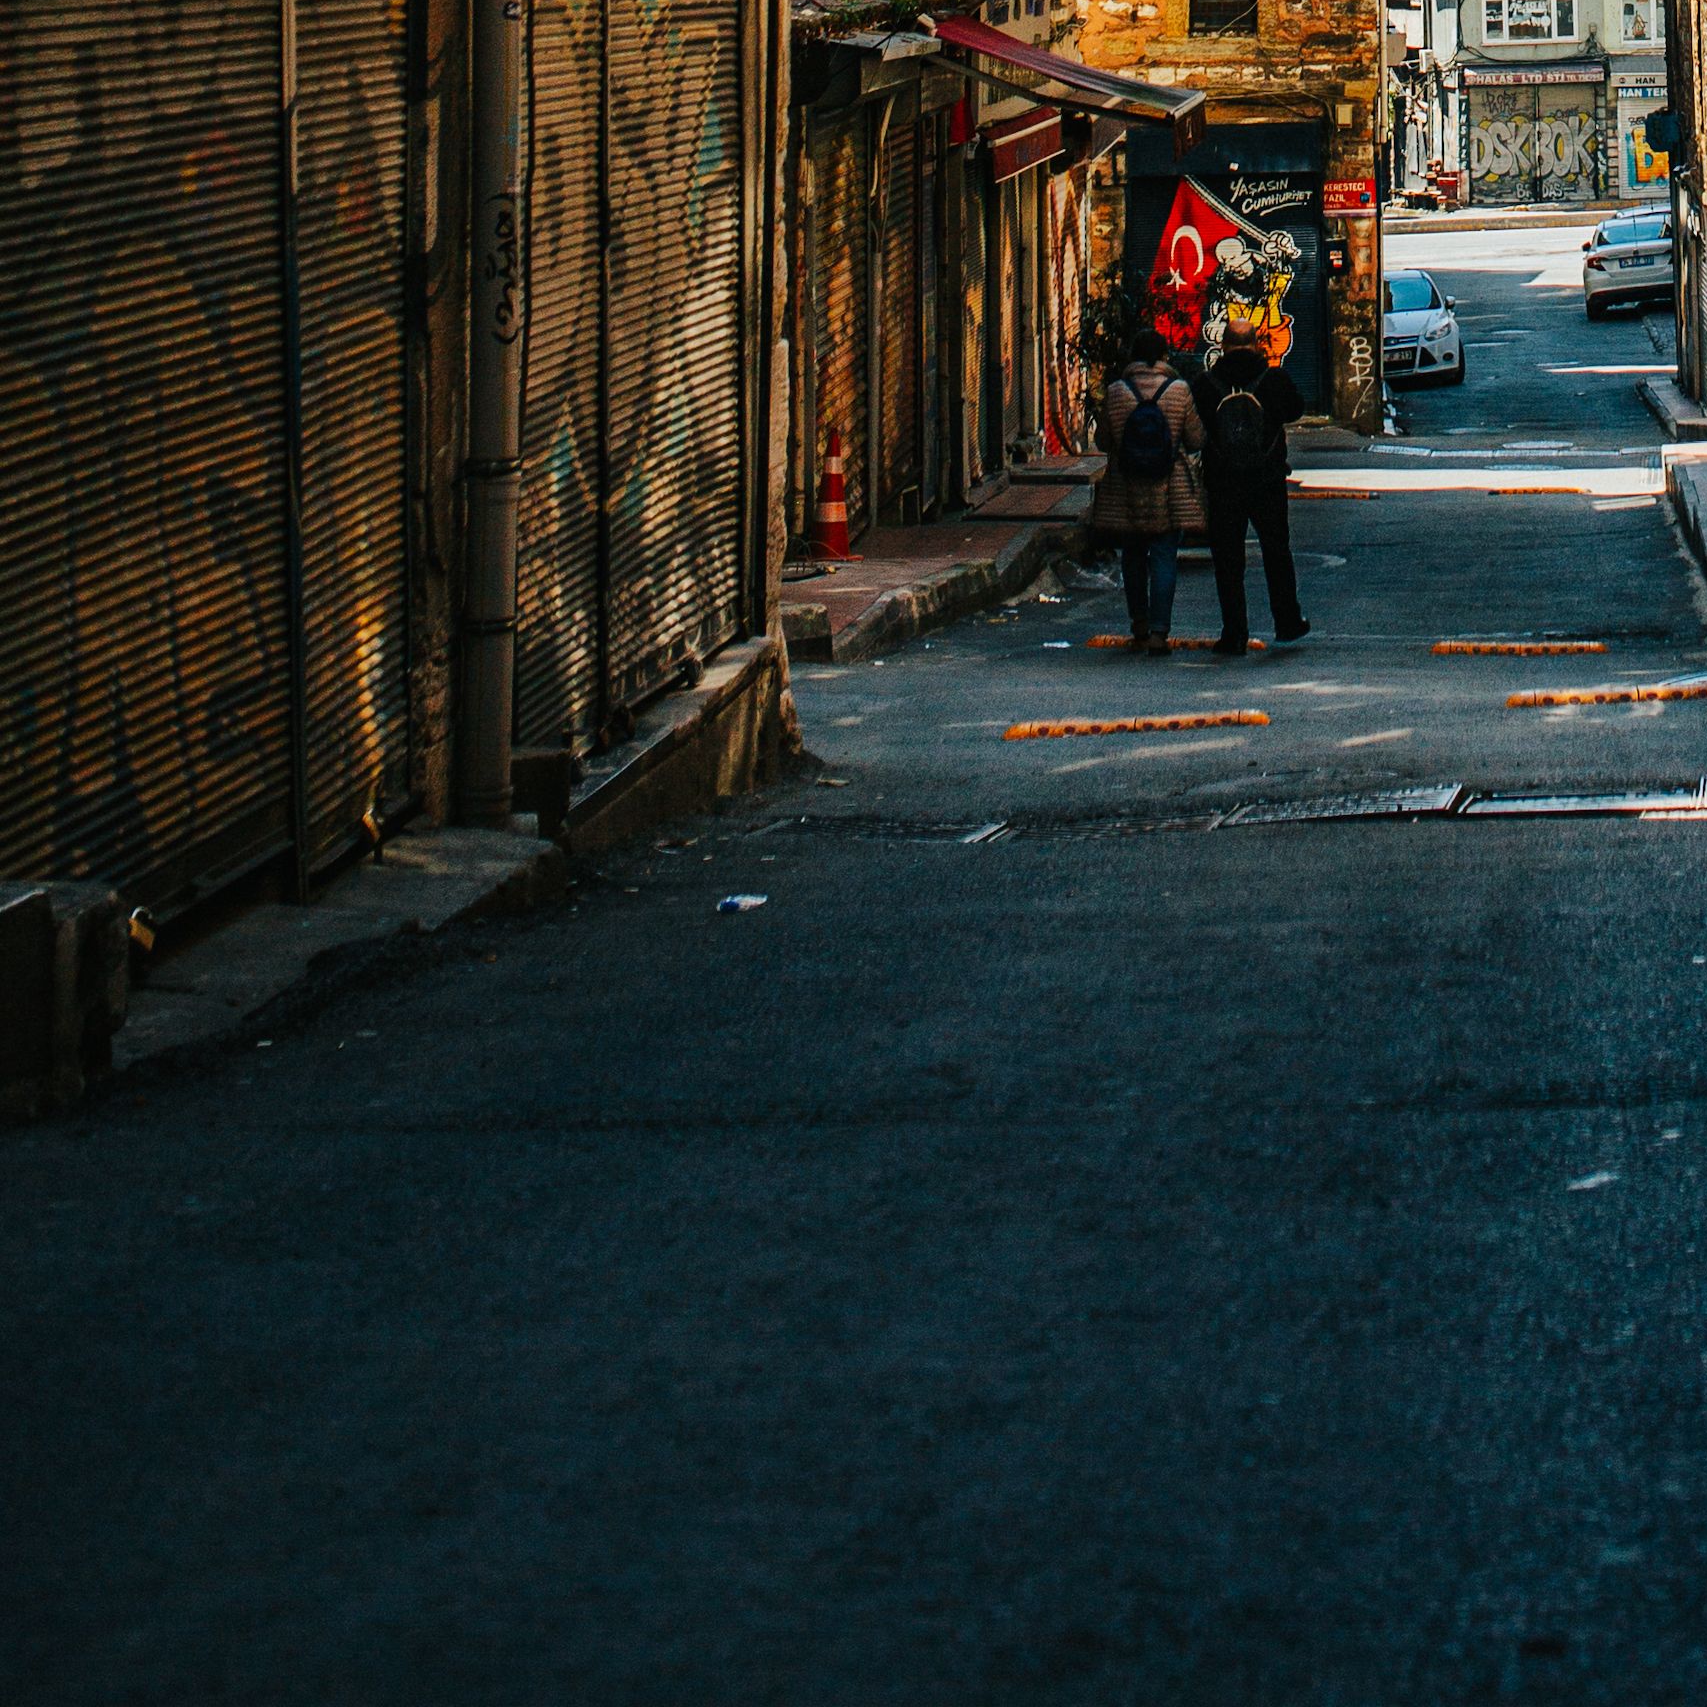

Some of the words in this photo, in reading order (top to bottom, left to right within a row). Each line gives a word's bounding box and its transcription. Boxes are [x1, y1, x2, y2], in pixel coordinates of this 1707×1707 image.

[1521, 73, 1543, 84] LTD
[1635, 76, 1656, 85] HAN
[1617, 88, 1642, 98] HAN
[1230, 176, 1289, 203] YAŞASIN
[1323, 193, 1346, 202] FAZIL
